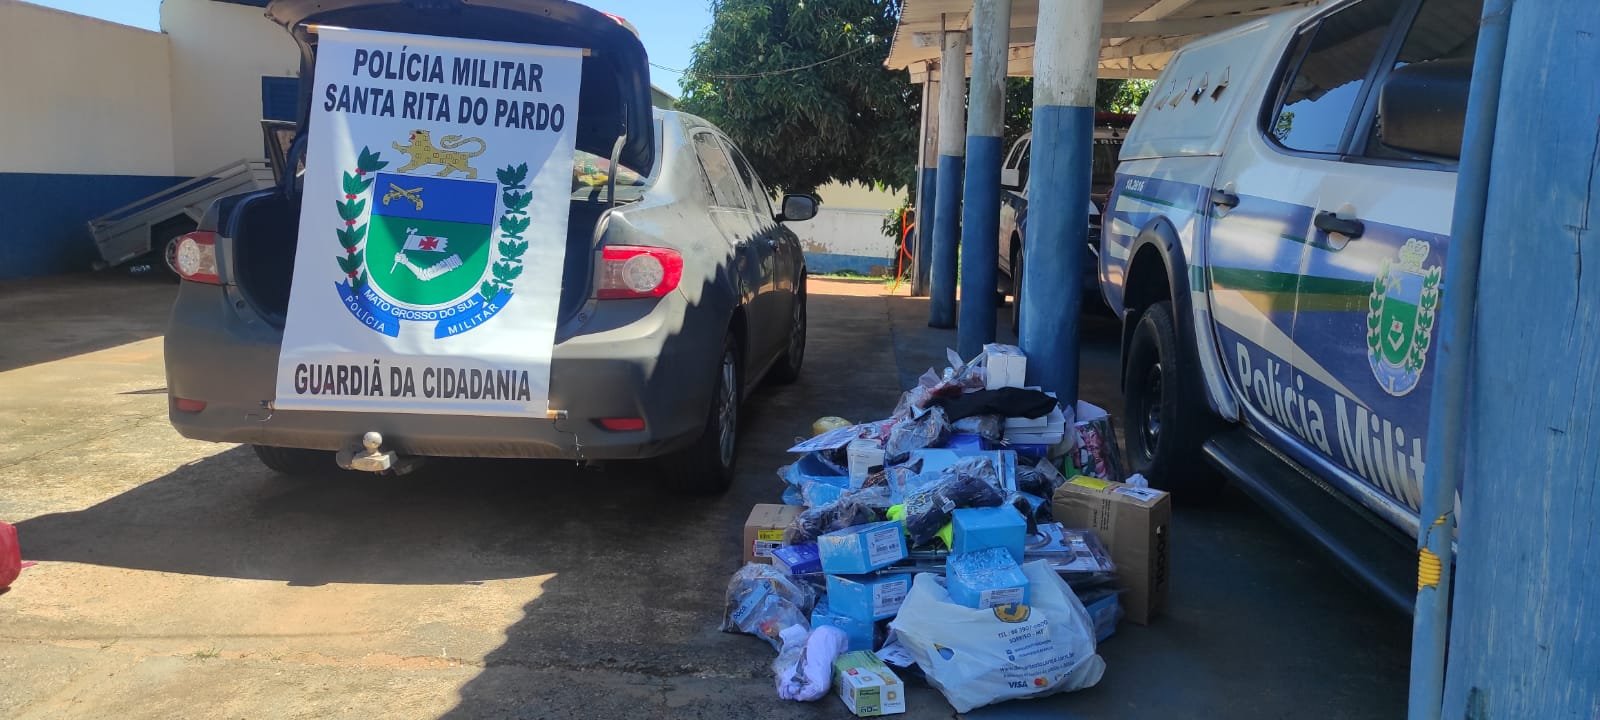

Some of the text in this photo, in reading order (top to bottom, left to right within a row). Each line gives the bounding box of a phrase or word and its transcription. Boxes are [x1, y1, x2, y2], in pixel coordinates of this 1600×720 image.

[352, 45, 544, 93] POLÍCIA MILITAR
[323, 83, 565, 133] SANTA RITA DO PARDO
[345, 295, 499, 335] POLÍCIA MILITAR
[363, 289, 479, 320] MATO GROSSO DO SUL
[294, 358, 531, 402] GUARDIÃ DA CIDADANIA
[1236, 342, 1425, 513] Polícia Milit
[1008, 680, 1029, 689] VISA
